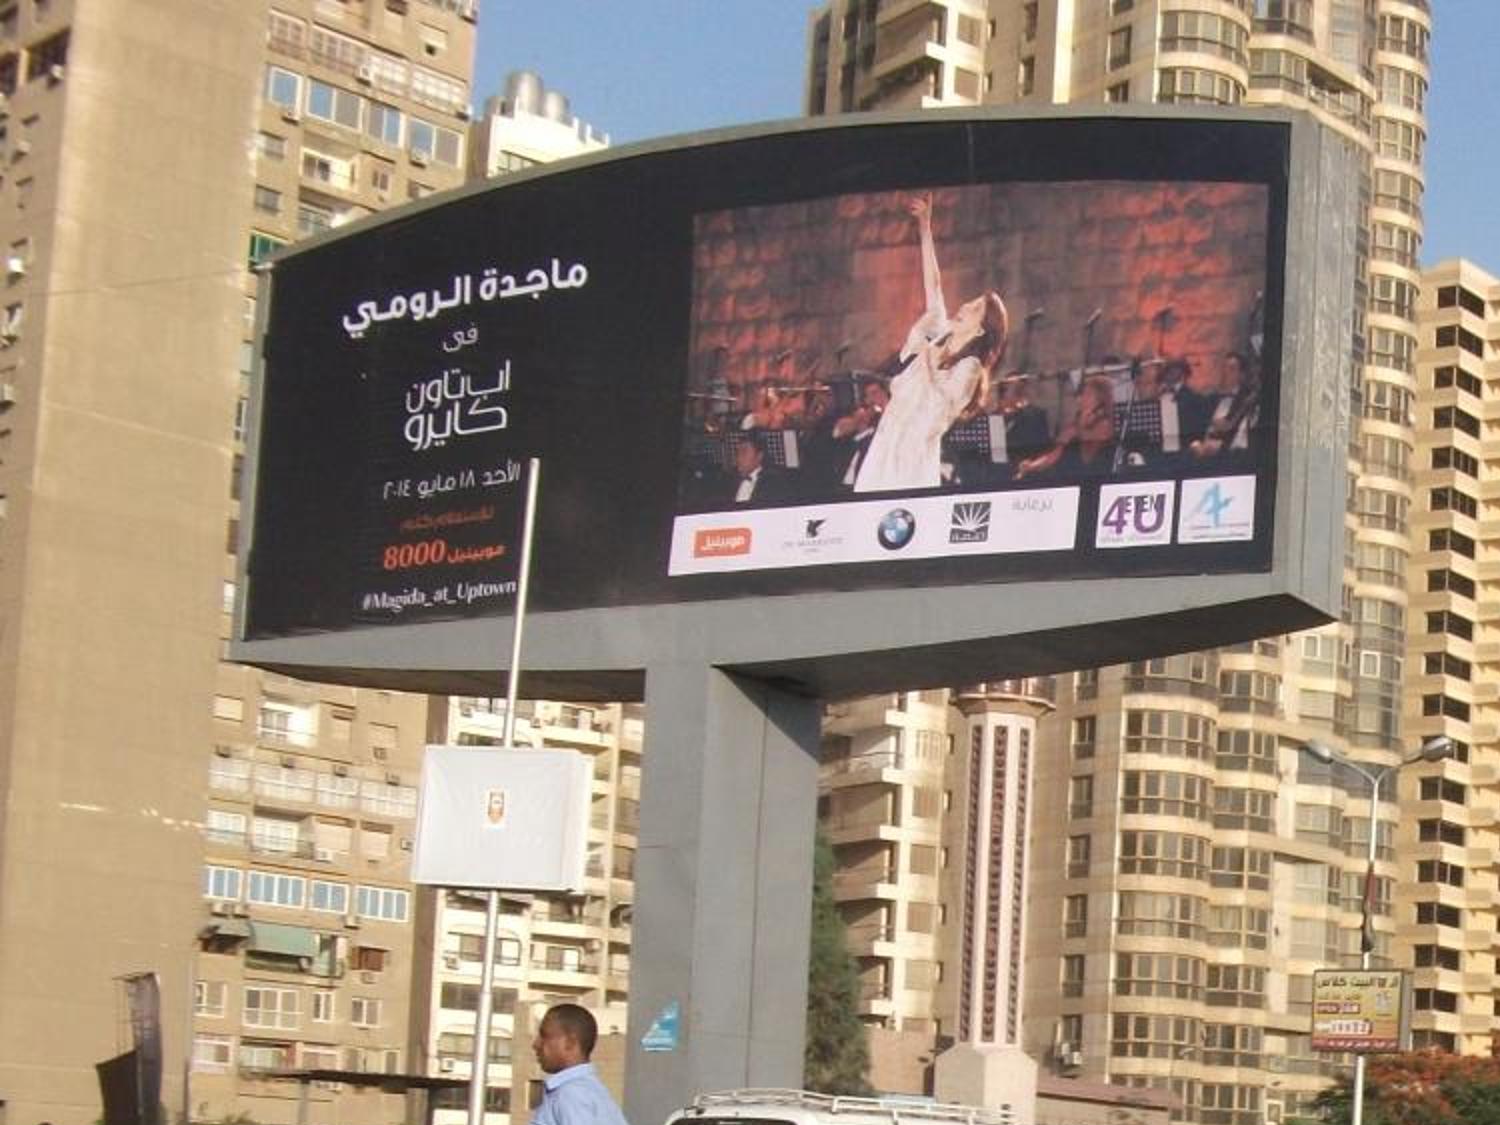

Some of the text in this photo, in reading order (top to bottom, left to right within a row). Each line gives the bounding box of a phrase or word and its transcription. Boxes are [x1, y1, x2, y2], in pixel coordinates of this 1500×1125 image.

[342, 258, 588, 338] ماجدة الرومي
[404, 398, 508, 451] كايرو
[417, 473, 456, 498] مايو
[482, 458, 521, 486] الأحد
[383, 539, 446, 571] 8000
